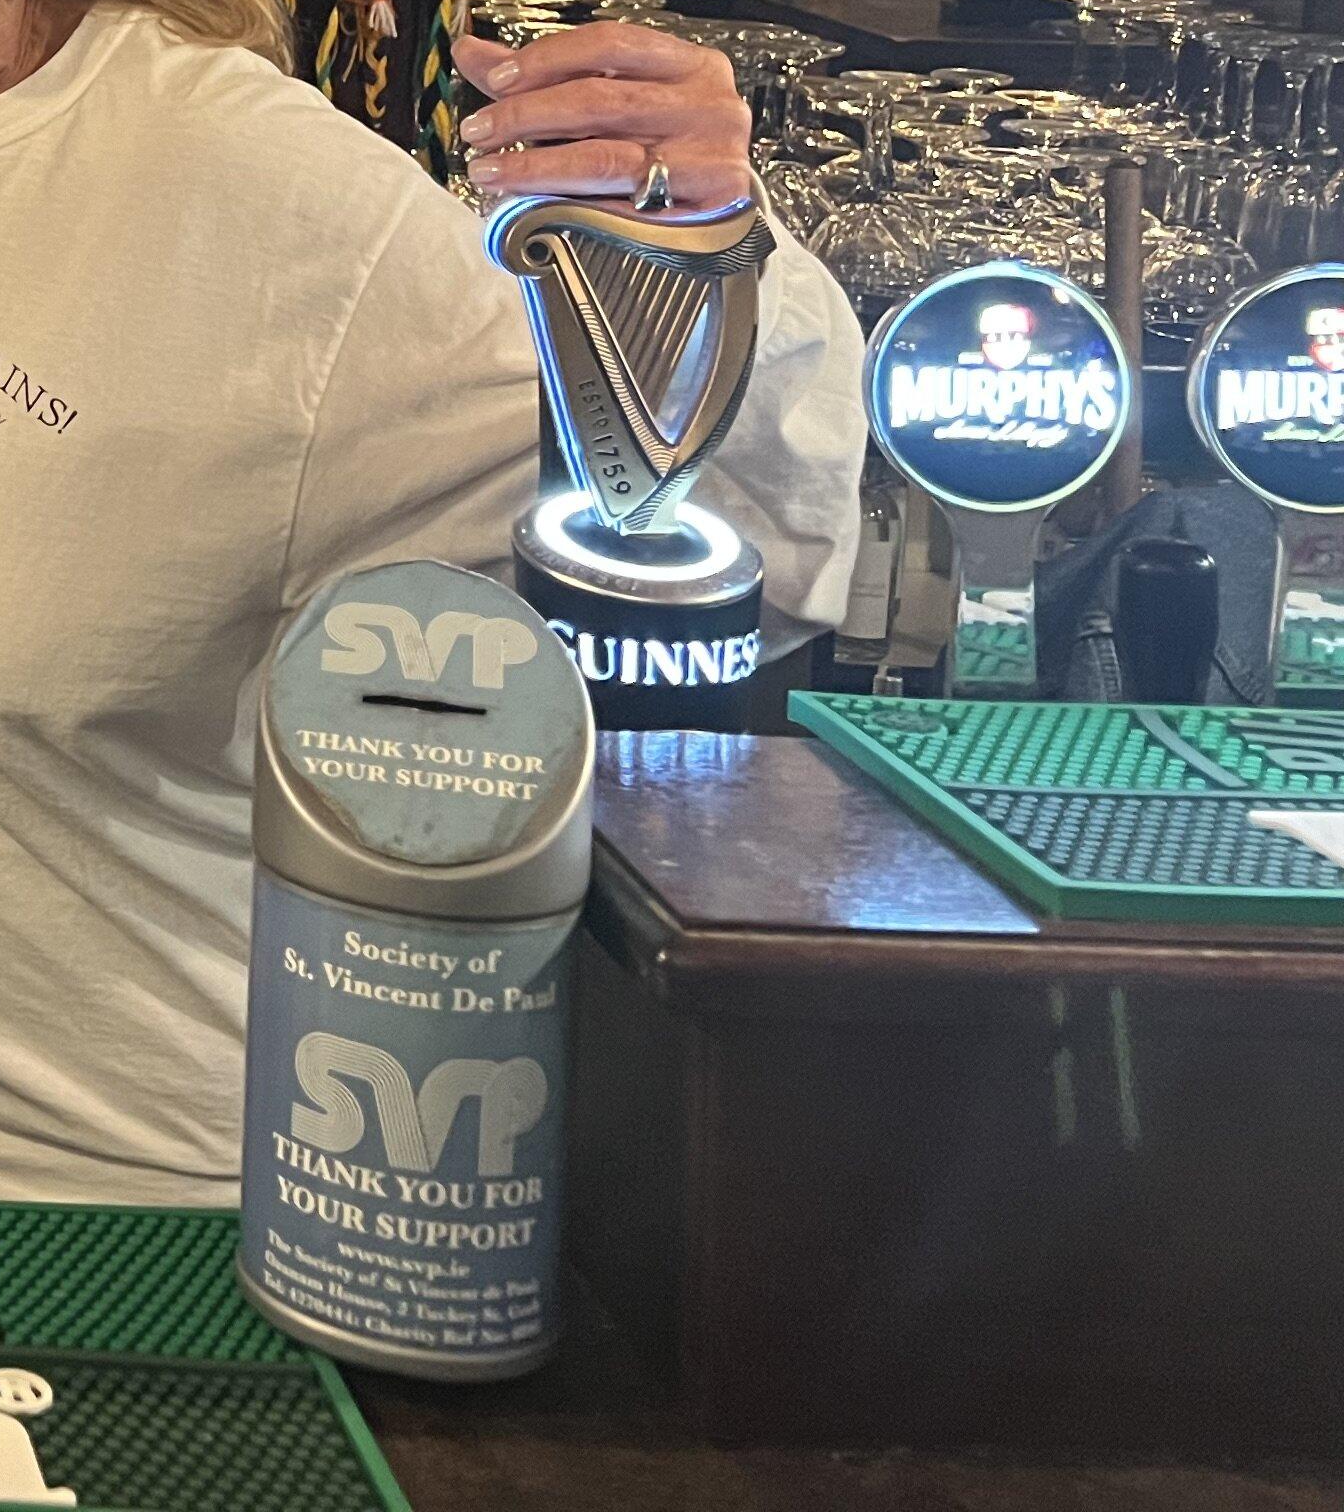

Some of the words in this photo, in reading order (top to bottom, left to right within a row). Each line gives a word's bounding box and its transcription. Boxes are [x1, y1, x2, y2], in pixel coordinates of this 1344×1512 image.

[890, 356, 1117, 430] MURPHY'S
[592, 433, 633, 496] 1759
[320, 601, 539, 690] SVP
[296, 729, 405, 760] THANK
[411, 742, 475, 767] YOU
[482, 750, 546, 775] FOR
[303, 756, 389, 784] YOUR
[394, 768, 540, 801] SUPPORT
[283, 946, 315, 981] St.
[321, 962, 443, 1011] Vincent
[451, 987, 495, 1013] De
[343, 930, 459, 980] Society
[467, 949, 503, 975] of
[290, 1030, 549, 1178] SVP
[271, 1131, 388, 1199] THANK
[394, 1174, 477, 1210] YOU
[483, 1176, 543, 1209] FOR
[276, 1174, 369, 1235] YOUR
[374, 1211, 537, 1252] SUPPORT
[336, 1241, 472, 1282] www.svp.ie
